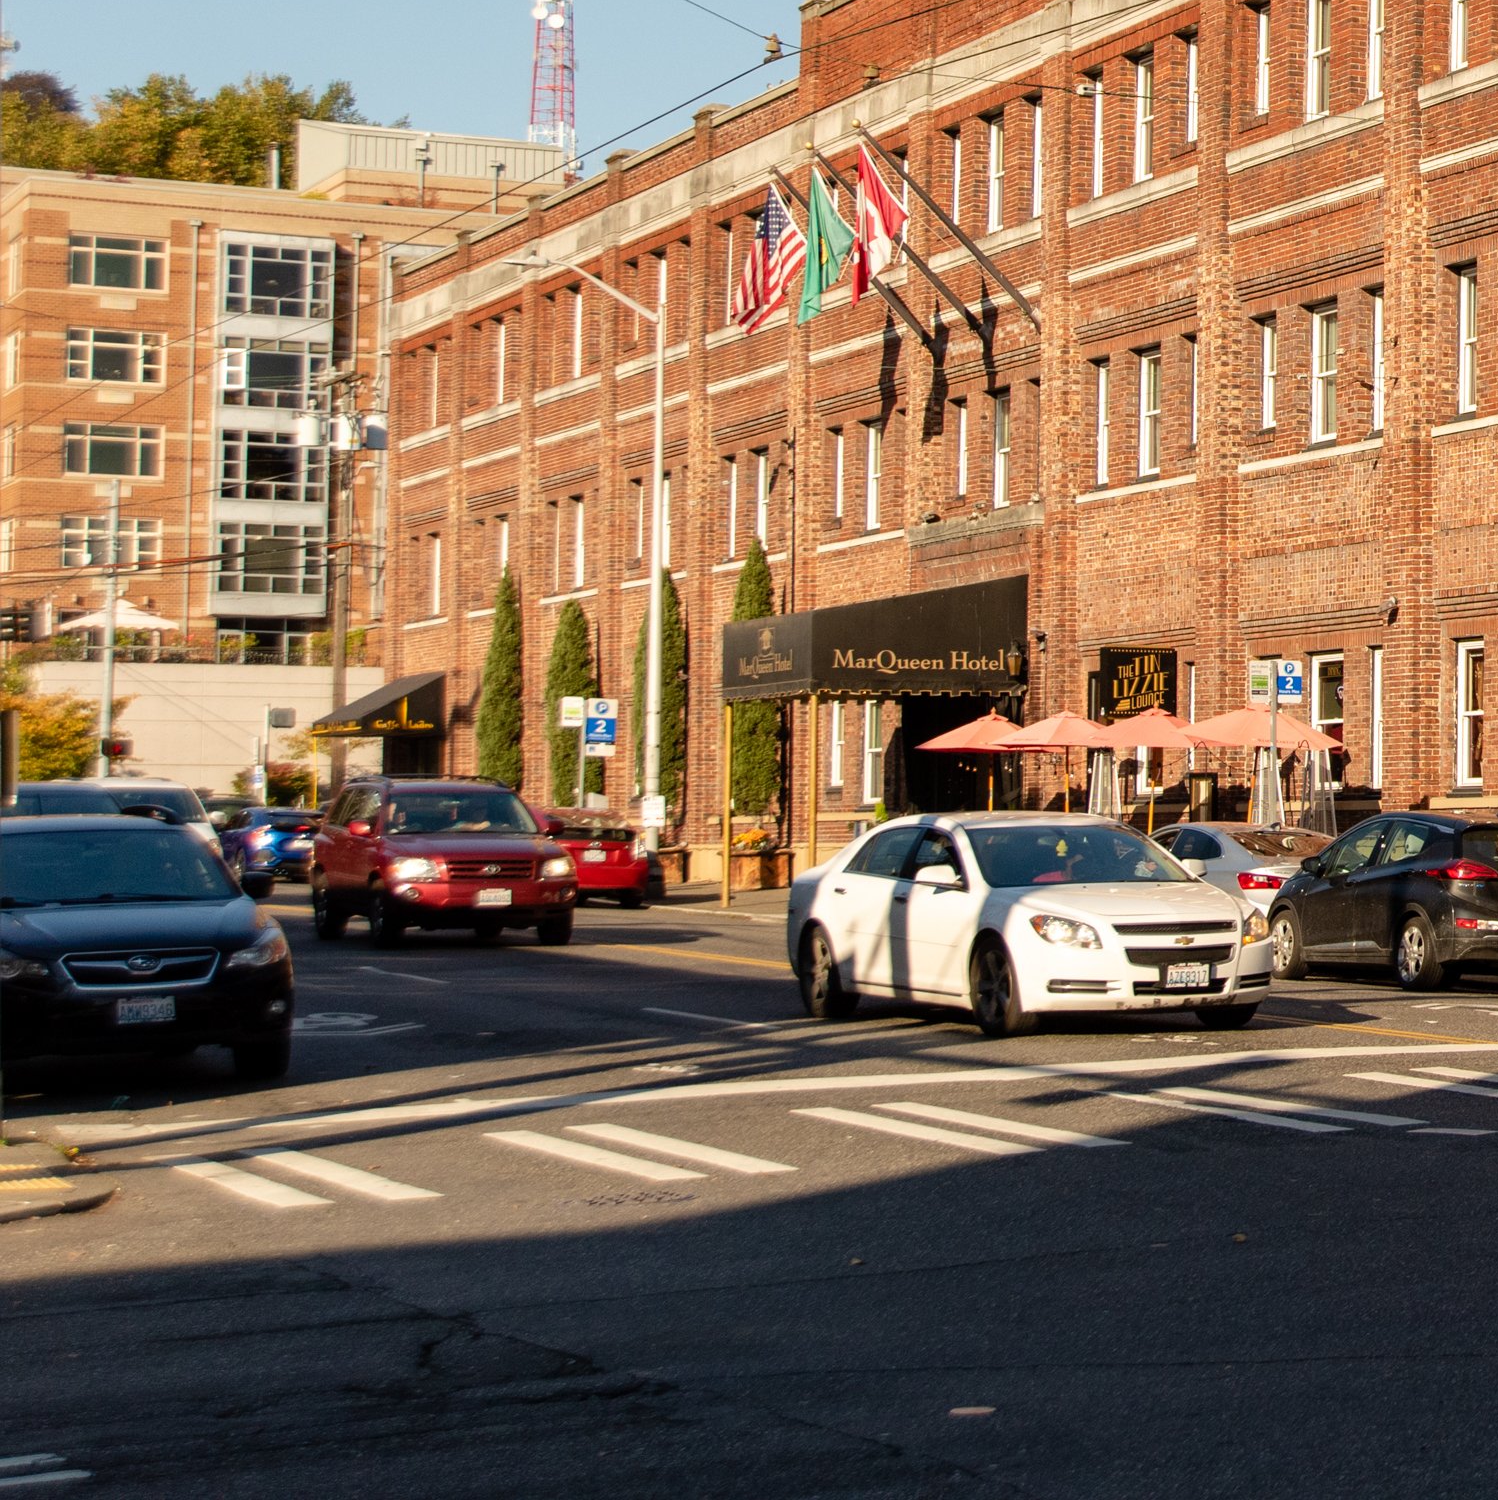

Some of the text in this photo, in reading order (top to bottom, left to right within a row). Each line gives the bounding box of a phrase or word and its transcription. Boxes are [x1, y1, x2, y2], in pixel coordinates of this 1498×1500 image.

[739, 649, 793, 679] MarQueen Hotel
[832, 649, 1005, 674] MarQueen Hotel
[1117, 654, 1160, 679] THE TIN
[1113, 672, 1169, 698] LIZZIE
[1285, 677, 1293, 689] 2
[1131, 691, 1165, 710] LOUNGE
[594, 719, 607, 733] 2
